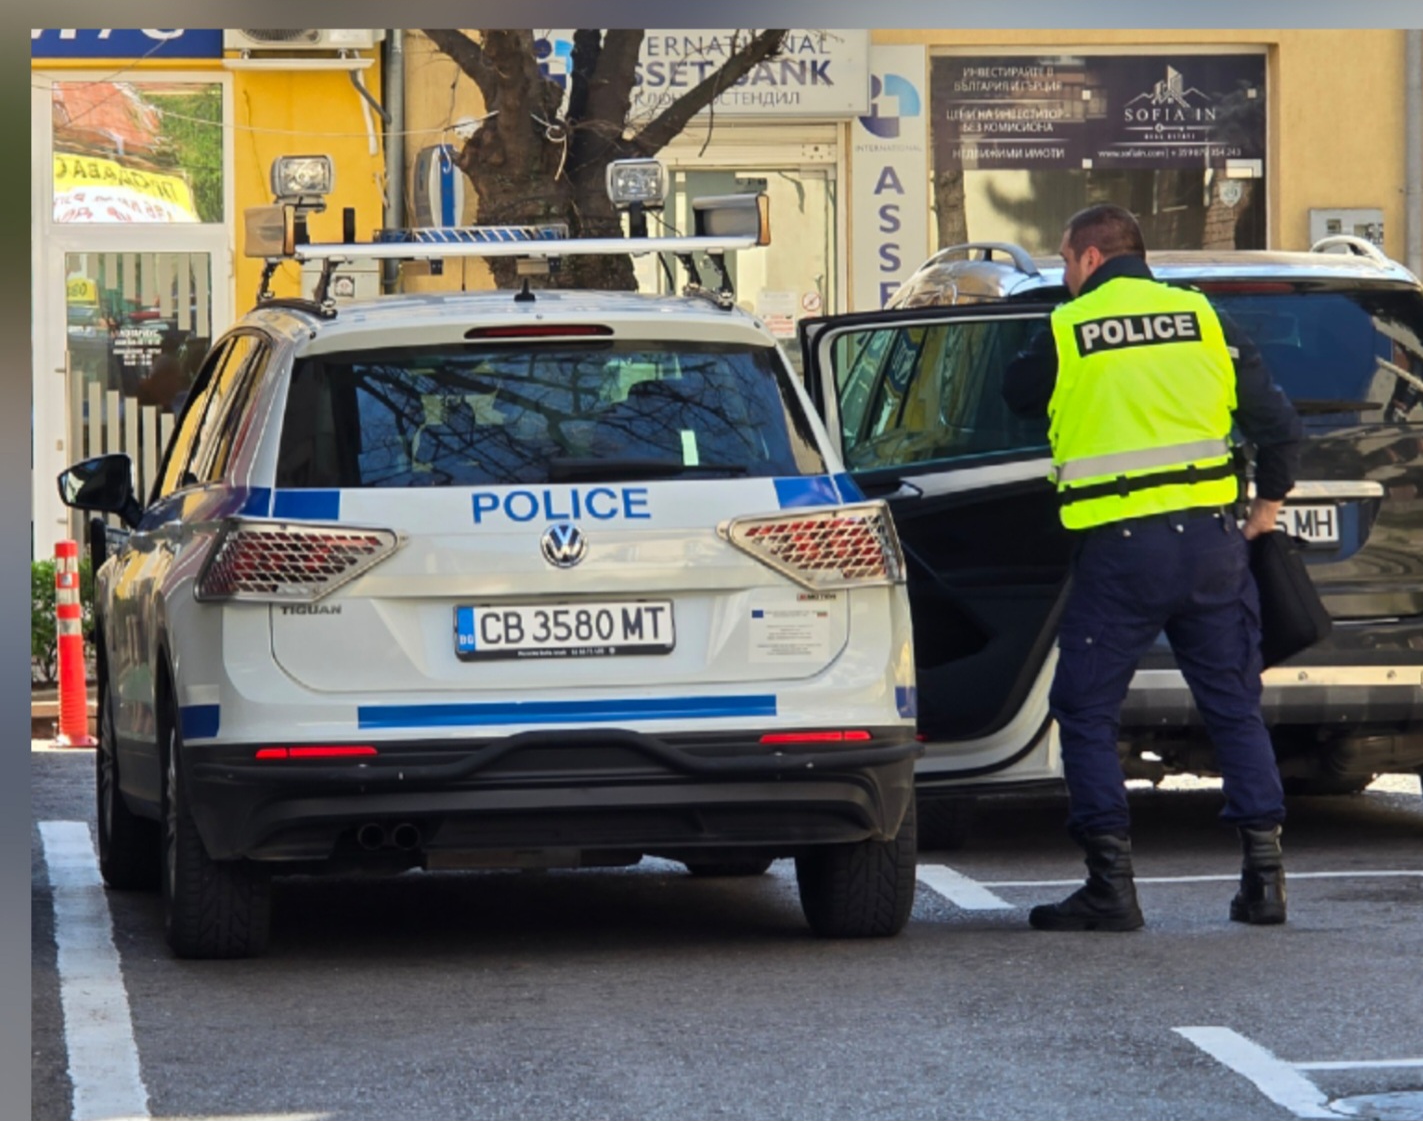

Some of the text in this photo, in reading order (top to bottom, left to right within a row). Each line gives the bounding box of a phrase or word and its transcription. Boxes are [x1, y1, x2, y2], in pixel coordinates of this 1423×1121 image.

[634, 60, 834, 87] SET ANK
[954, 81, 1009, 92] БЪЛГАРИЯ
[713, 92, 800, 107] СТЕНДИЛ
[1124, 108, 1217, 122] SOFIA IN
[984, 122, 1054, 133] КОМИСИОНА
[1025, 148, 1065, 159] ИМОТИ
[1081, 315, 1196, 350] POLICE
[472, 488, 651, 524] POLICE
[1295, 509, 1332, 537] MH
[281, 605, 342, 616] TIGUAN
[480, 606, 665, 645] CB 3580 MT
[459, 634, 475, 645] BG
